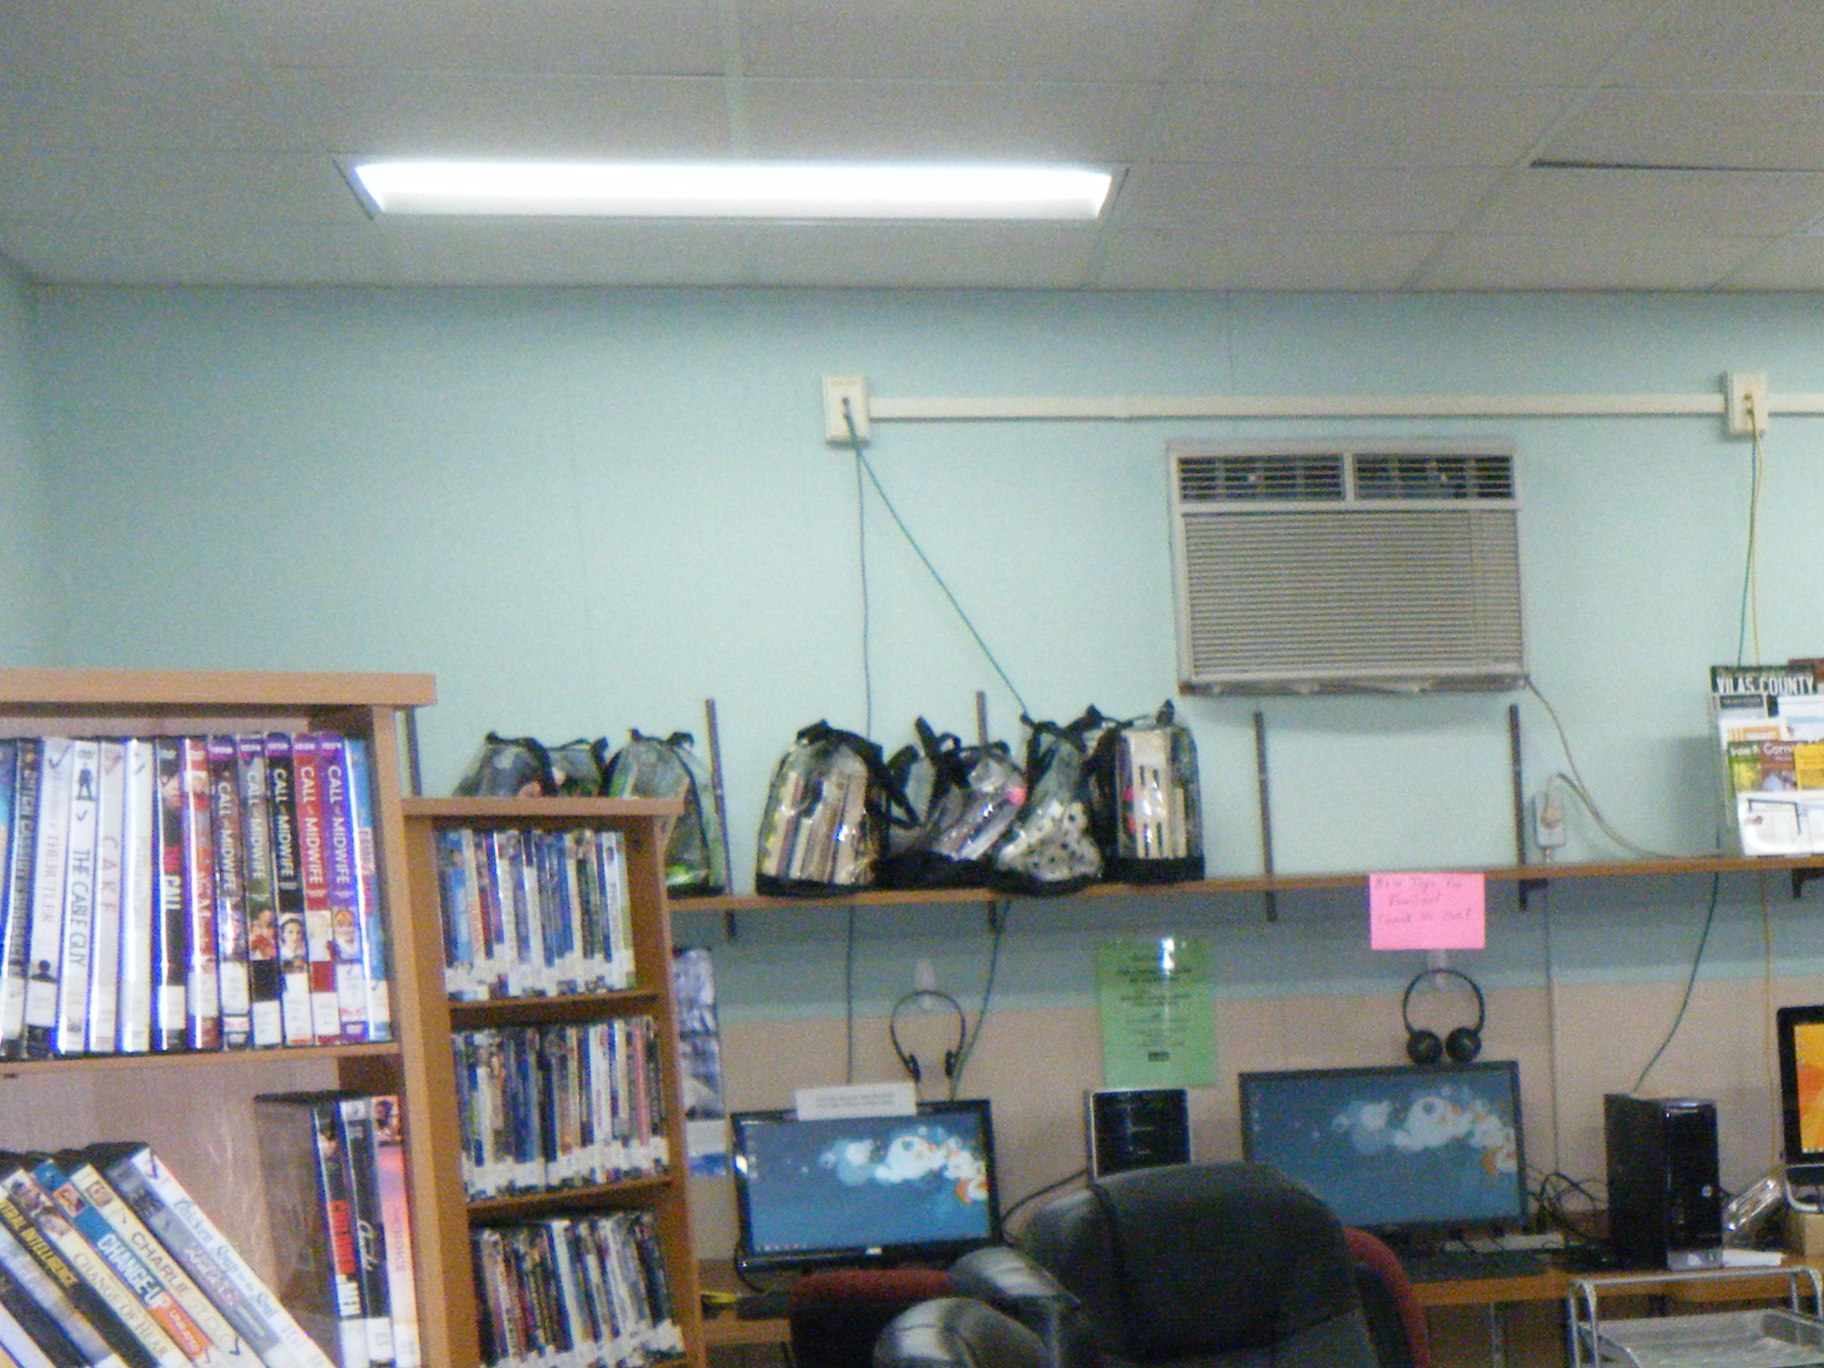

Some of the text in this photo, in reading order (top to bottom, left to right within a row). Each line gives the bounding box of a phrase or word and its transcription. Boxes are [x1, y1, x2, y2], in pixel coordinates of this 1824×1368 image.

[1716, 675, 1815, 697] VILAS COUNTY
[101, 836, 118, 910] CAKE
[218, 782, 237, 892] CALL MIDWIFE
[247, 770, 267, 880] CALL MIDWIFE
[273, 768, 294, 878] CALL MIDWIFE
[300, 766, 323, 885] CALL MIDWIFE
[329, 765, 350, 886] CALL MIDWIFE
[68, 849, 90, 968] THE CABLE GUY
[165, 873, 182, 909] CALL
[97, 1232, 172, 1310] CHANGE-UP
[131, 1231, 189, 1296] CHARLIE
[174, 1198, 213, 1244] Chicken
[214, 1244, 240, 1275] Soup
[256, 1291, 279, 1319] Soul
